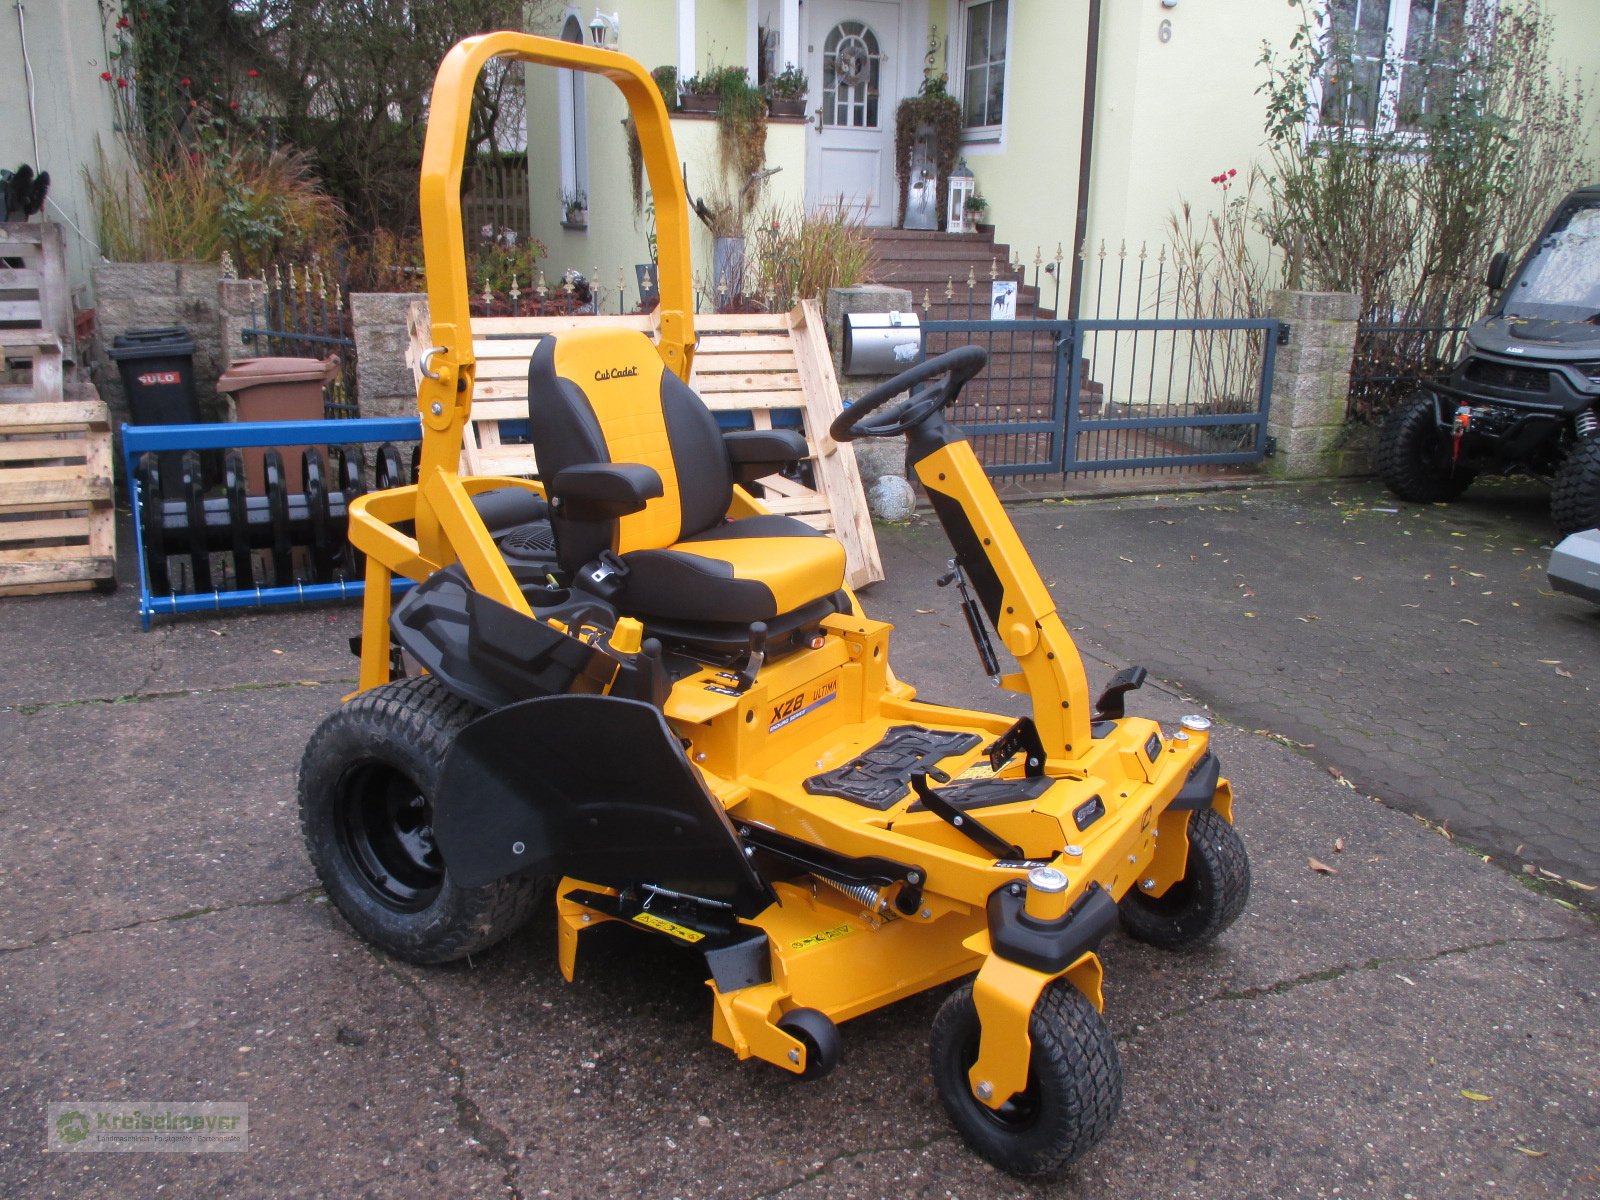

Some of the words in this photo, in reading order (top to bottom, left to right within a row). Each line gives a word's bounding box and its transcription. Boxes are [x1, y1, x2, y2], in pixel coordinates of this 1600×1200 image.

[1159, 19, 1171, 43] 6
[138, 374, 174, 383] SULO
[594, 369, 610, 381] Cub
[611, 365, 637, 379] Cadet
[770, 693, 805, 724] XZ8
[812, 680, 837, 701] ULTIMA
